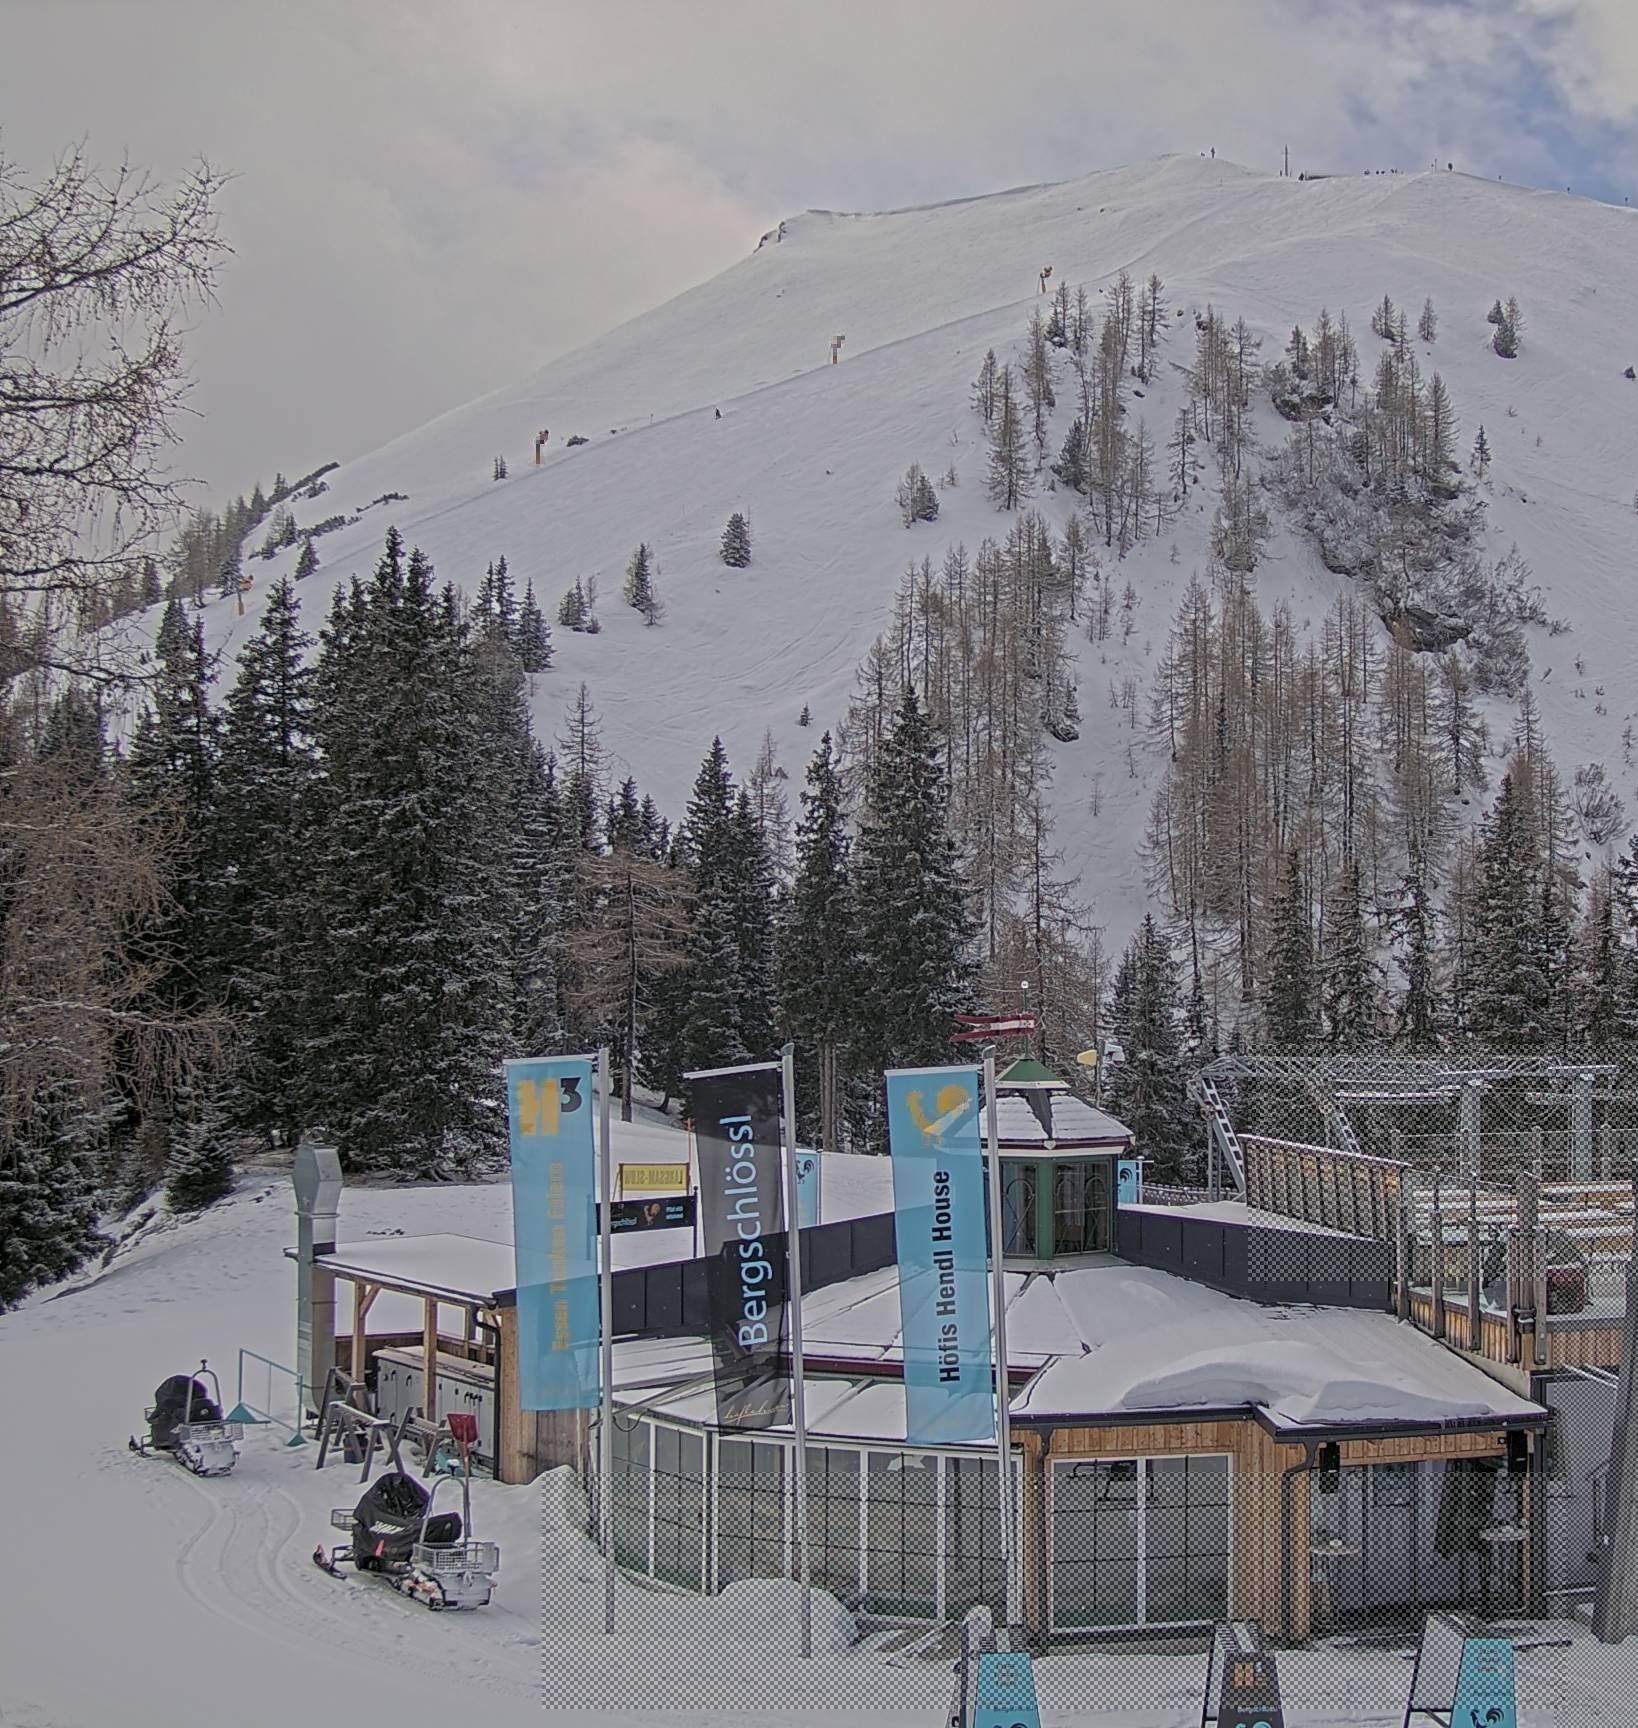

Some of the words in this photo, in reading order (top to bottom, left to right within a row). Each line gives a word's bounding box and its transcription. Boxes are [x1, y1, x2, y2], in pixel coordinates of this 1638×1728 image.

[719, 1115, 773, 1346] Bergschlössl
[931, 1170, 953, 1242] House
[933, 1248, 957, 1317] Hendl
[938, 1323, 961, 1384] Höfis
